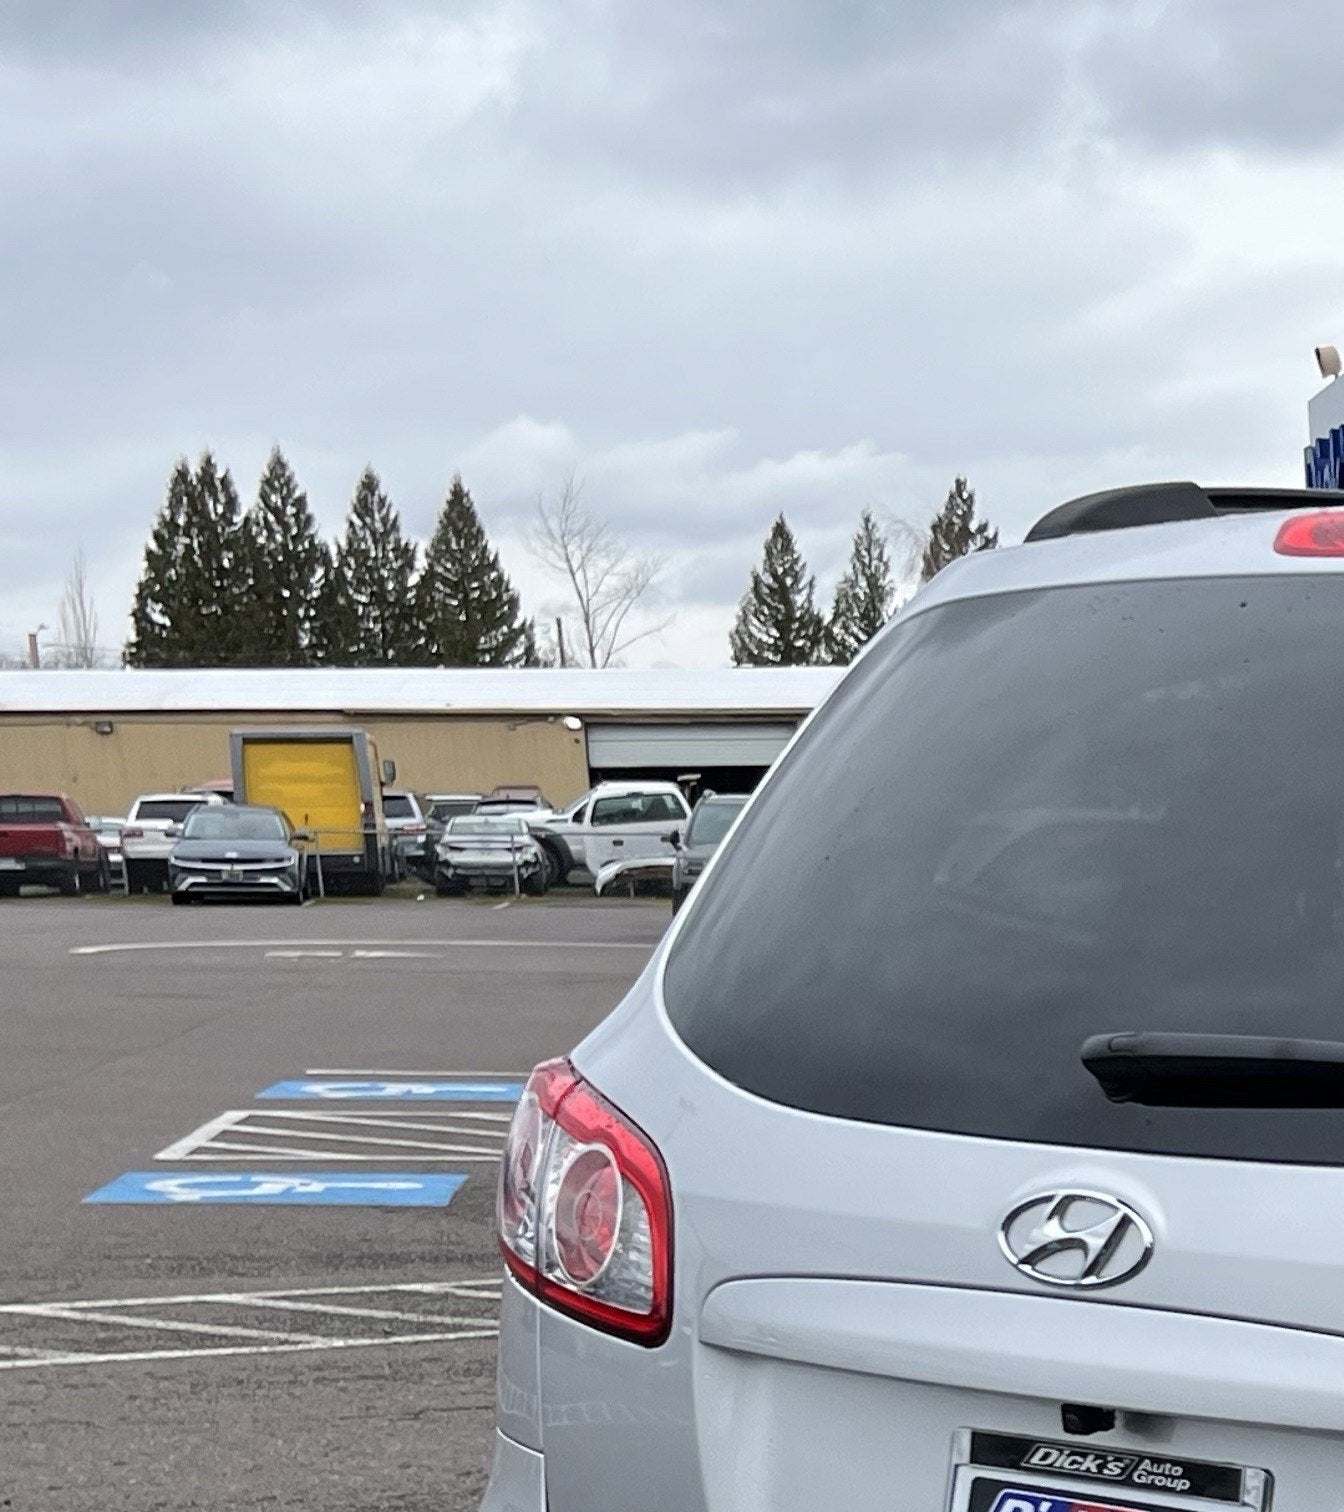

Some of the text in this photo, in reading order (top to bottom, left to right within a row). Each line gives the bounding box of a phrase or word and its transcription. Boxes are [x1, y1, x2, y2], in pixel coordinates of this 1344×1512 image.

[1029, 1445, 1130, 1478] Dick's
[1139, 1459, 1184, 1477] Auto
[1132, 1470, 1191, 1493] Group
